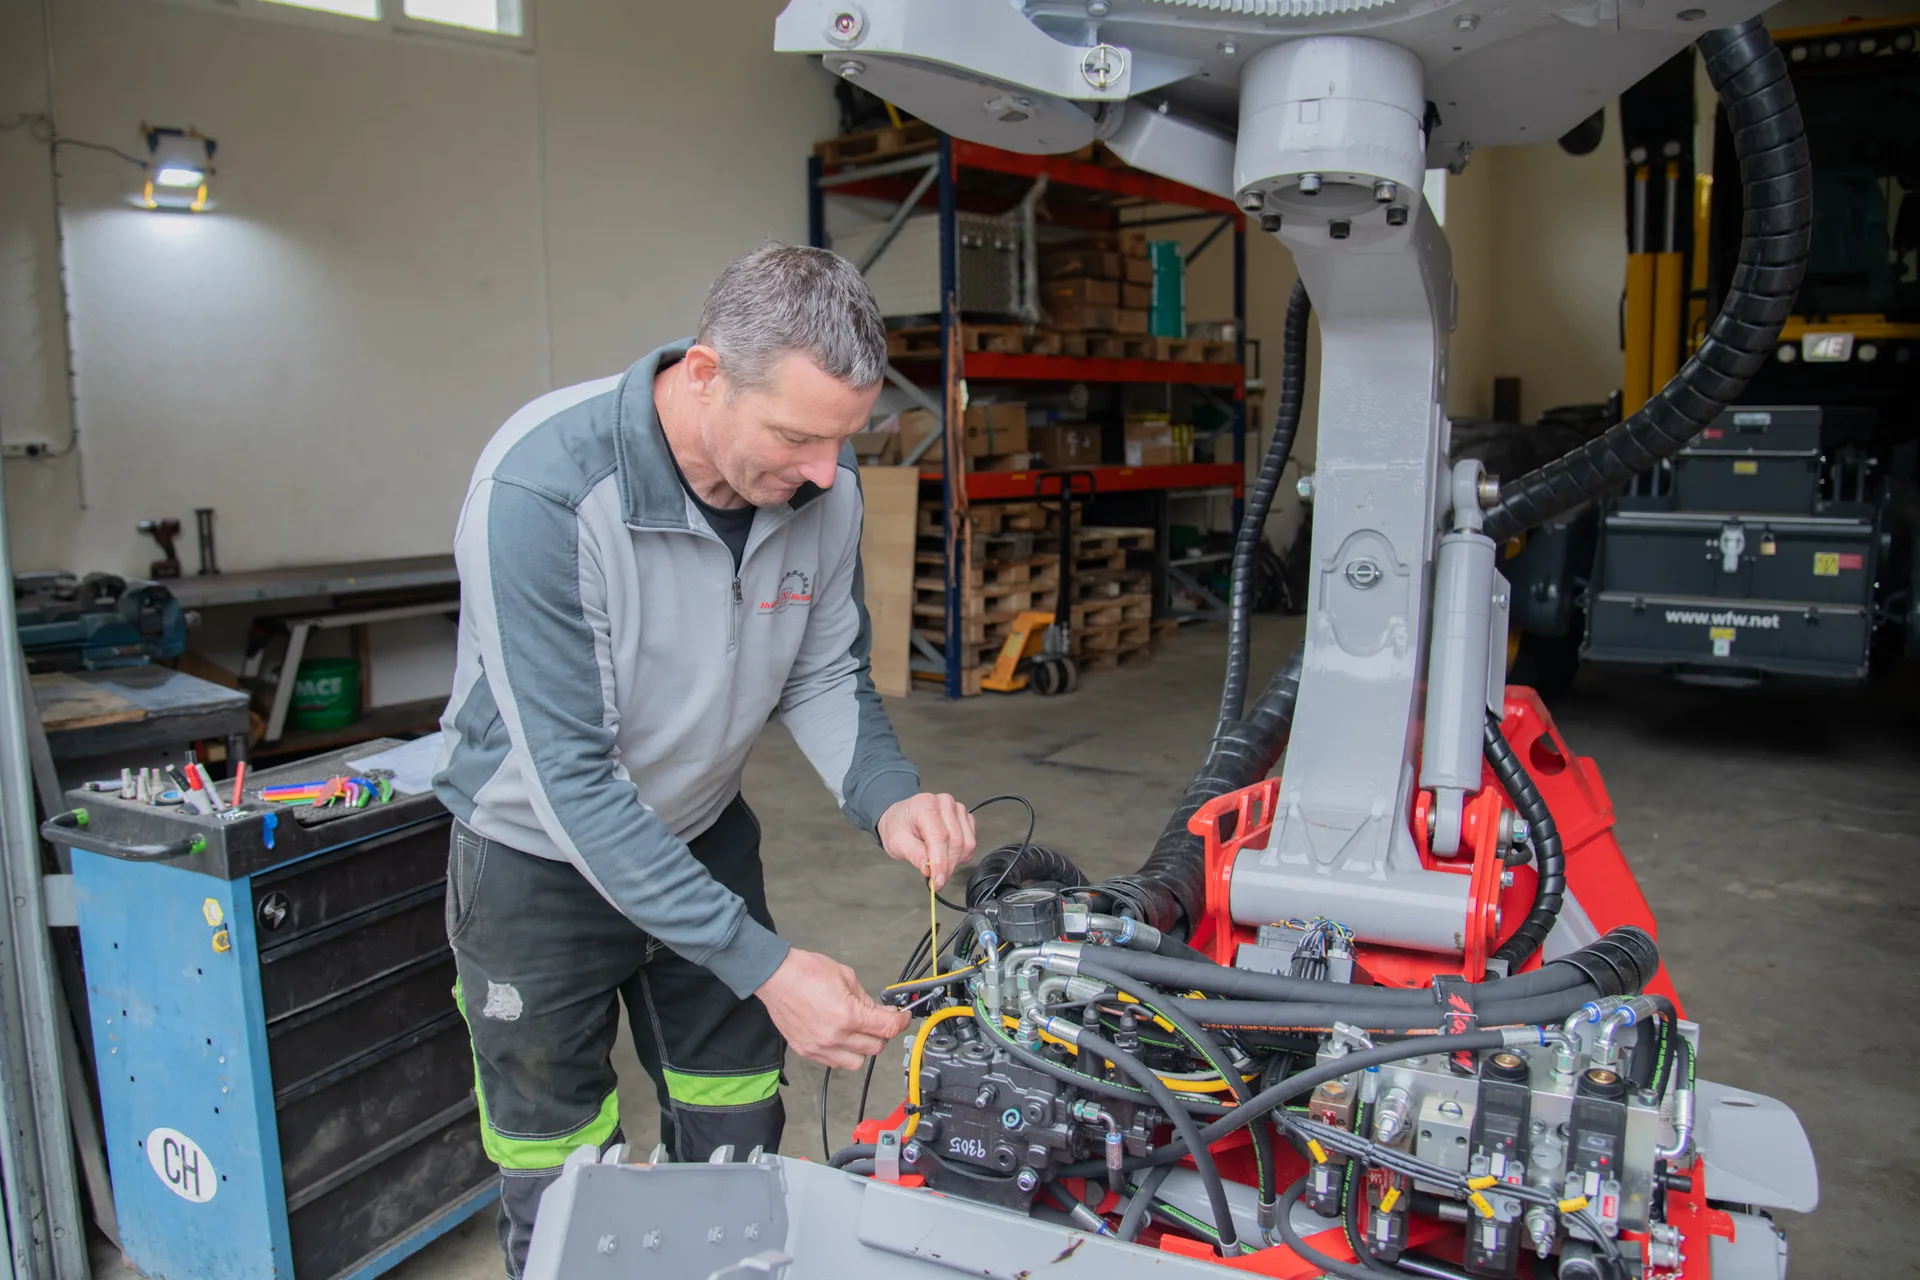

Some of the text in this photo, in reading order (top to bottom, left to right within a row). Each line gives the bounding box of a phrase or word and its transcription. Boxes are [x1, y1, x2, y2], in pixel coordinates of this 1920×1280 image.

[1665, 610, 1780, 629] www.wfw.net
[949, 1136, 986, 1158] 9305
[163, 1137, 200, 1196] CH
